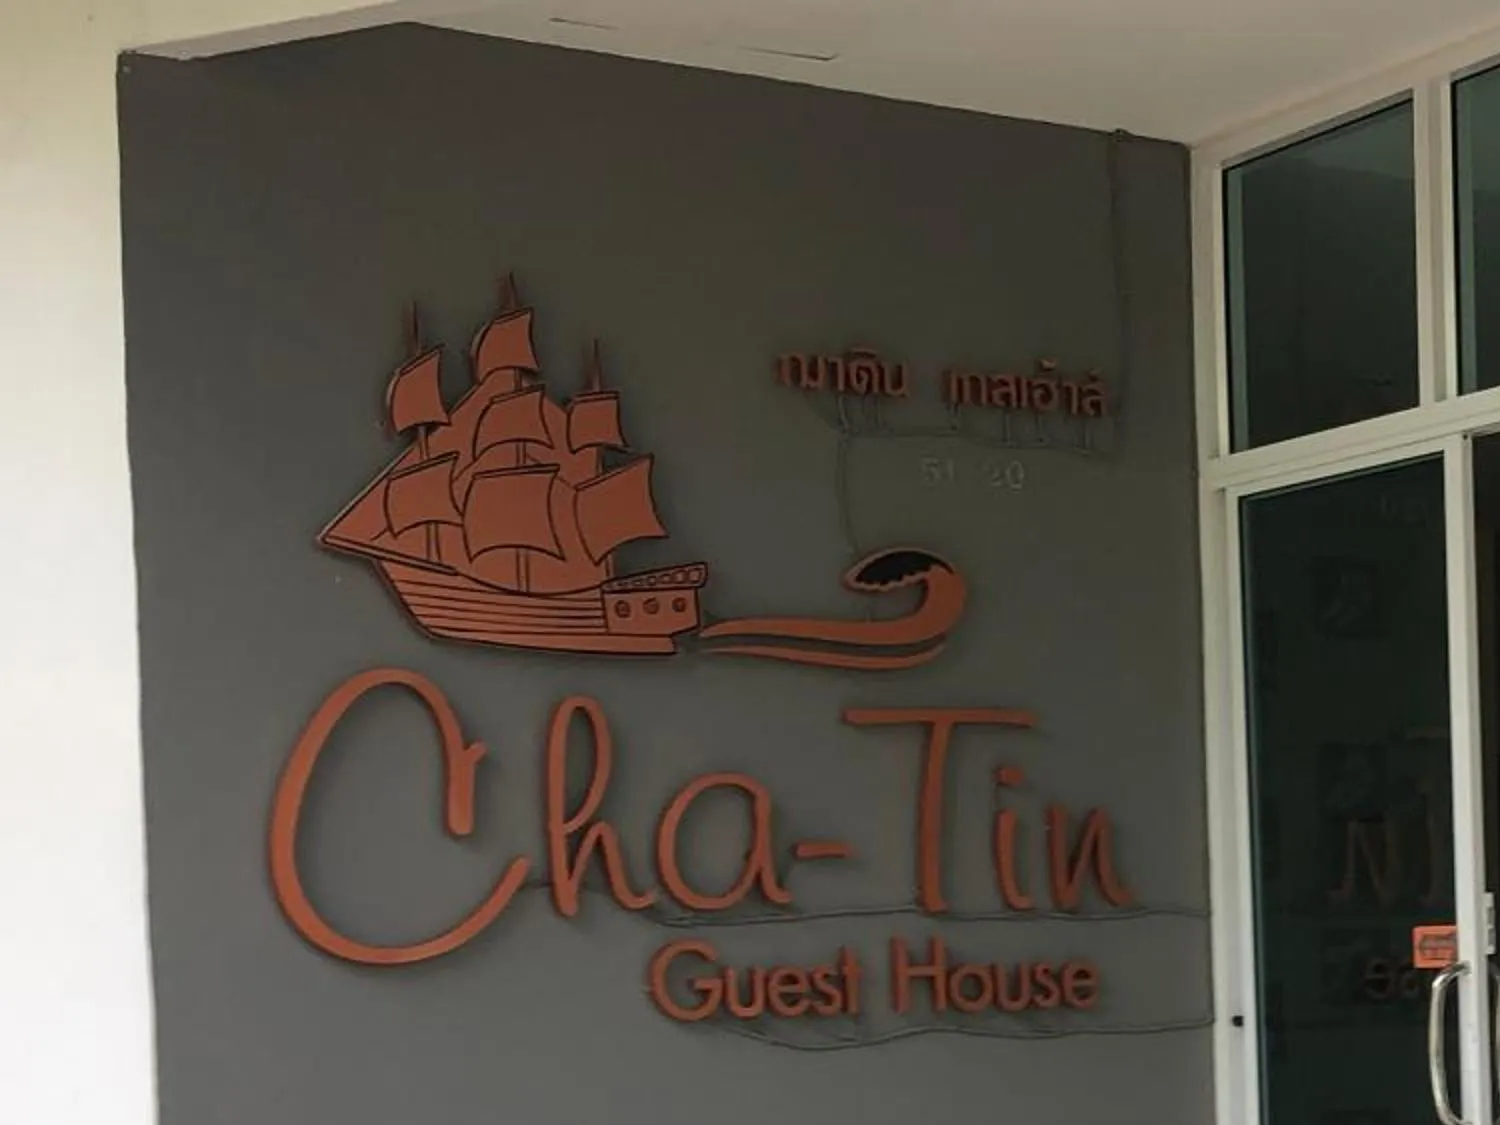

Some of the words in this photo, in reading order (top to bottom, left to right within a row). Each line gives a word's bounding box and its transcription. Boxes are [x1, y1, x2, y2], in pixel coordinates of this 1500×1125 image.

[267, 667, 1136, 966] Cha-Tin
[648, 936, 864, 1022] Guest
[891, 934, 1101, 1016] House
